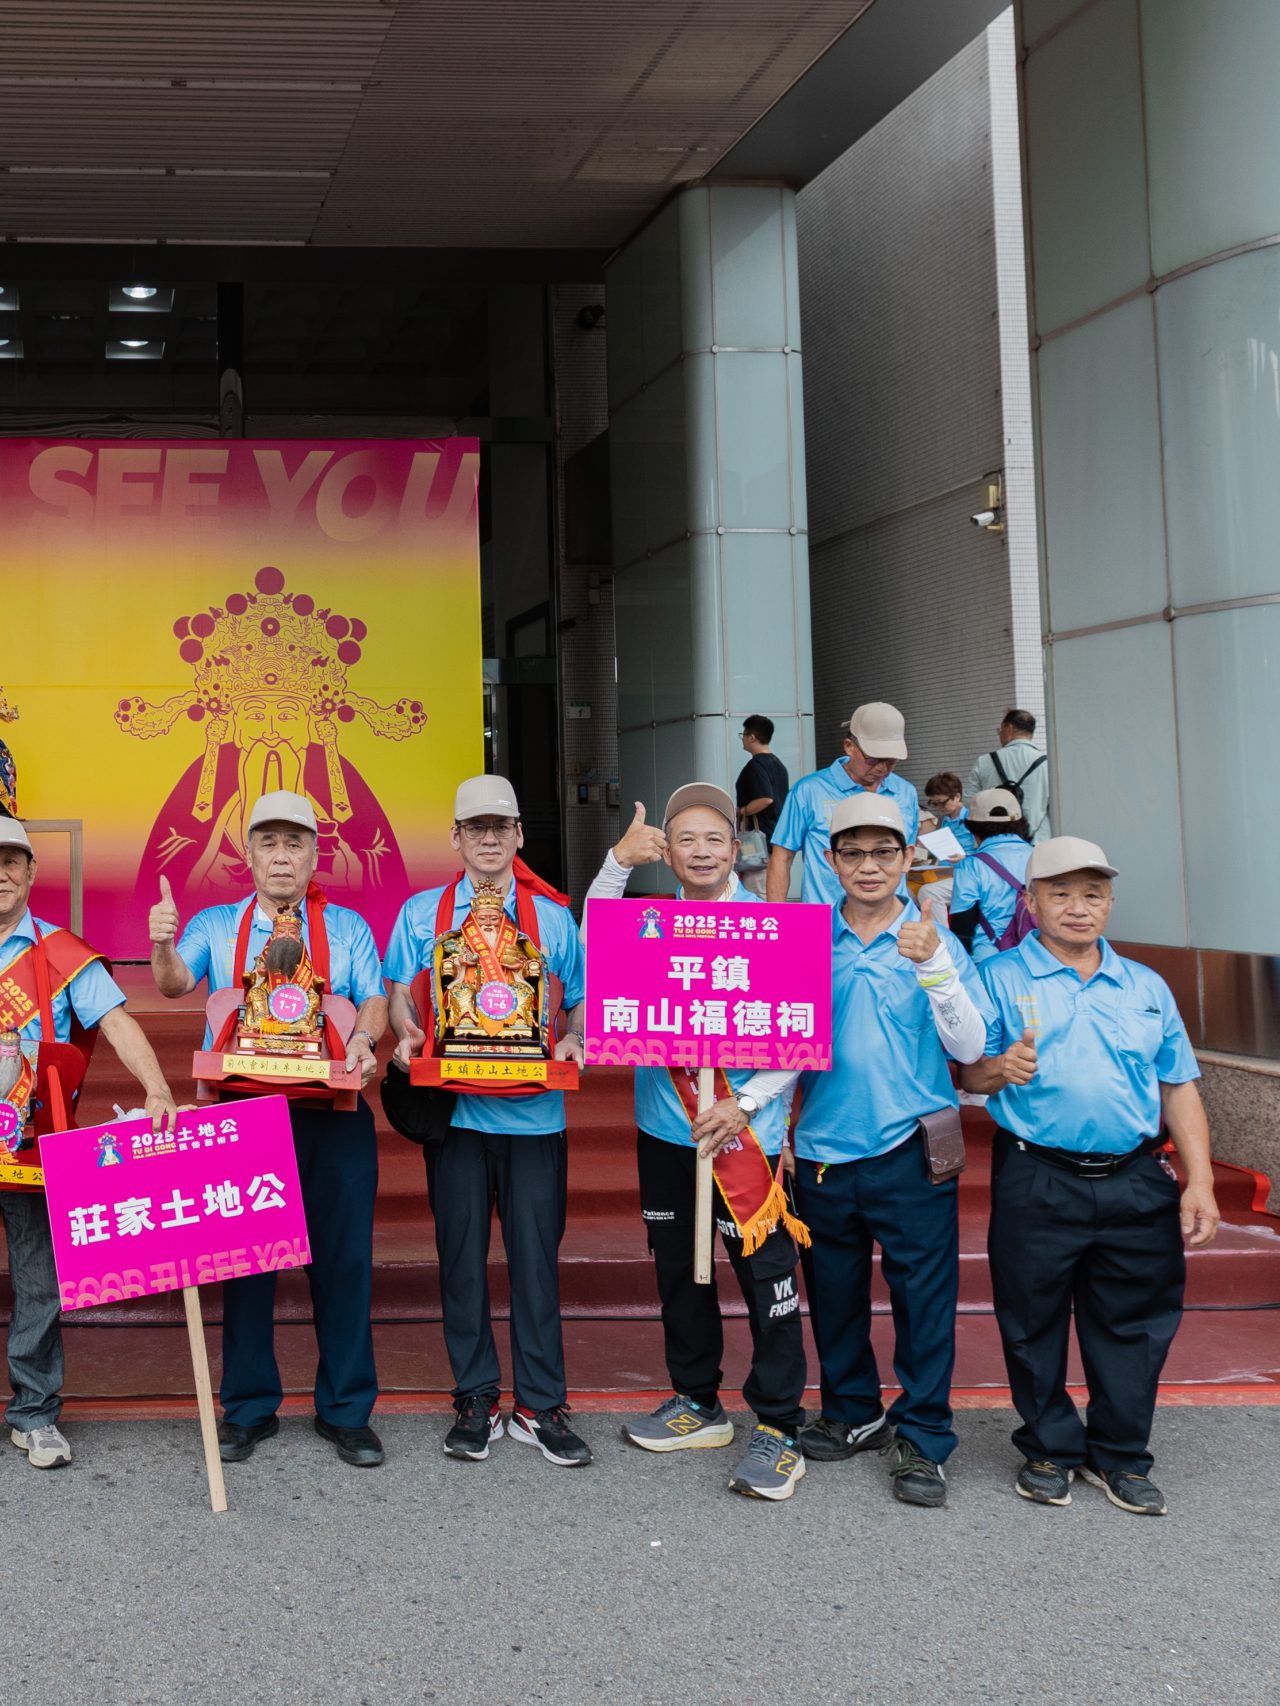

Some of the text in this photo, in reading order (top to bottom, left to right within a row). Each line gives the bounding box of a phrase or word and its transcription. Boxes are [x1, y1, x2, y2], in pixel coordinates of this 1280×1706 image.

[28, 445, 230, 540] SEE
[253, 449, 480, 541] YOU
[674, 915, 779, 931] 2025 土地公
[668, 955, 751, 993] 平鎮
[2, 977, 34, 1012] 2025
[279, 1000, 297, 1013] 1-1
[487, 998, 507, 1009] 1-6
[602, 997, 815, 1039] 南山福德祠
[443, 1063, 543, 1077] 平鎮南山土地公
[131, 1118, 238, 1148] 2025 土地公
[68, 1173, 287, 1247] 莊家土地公
[773, 1276, 793, 1301] VK
